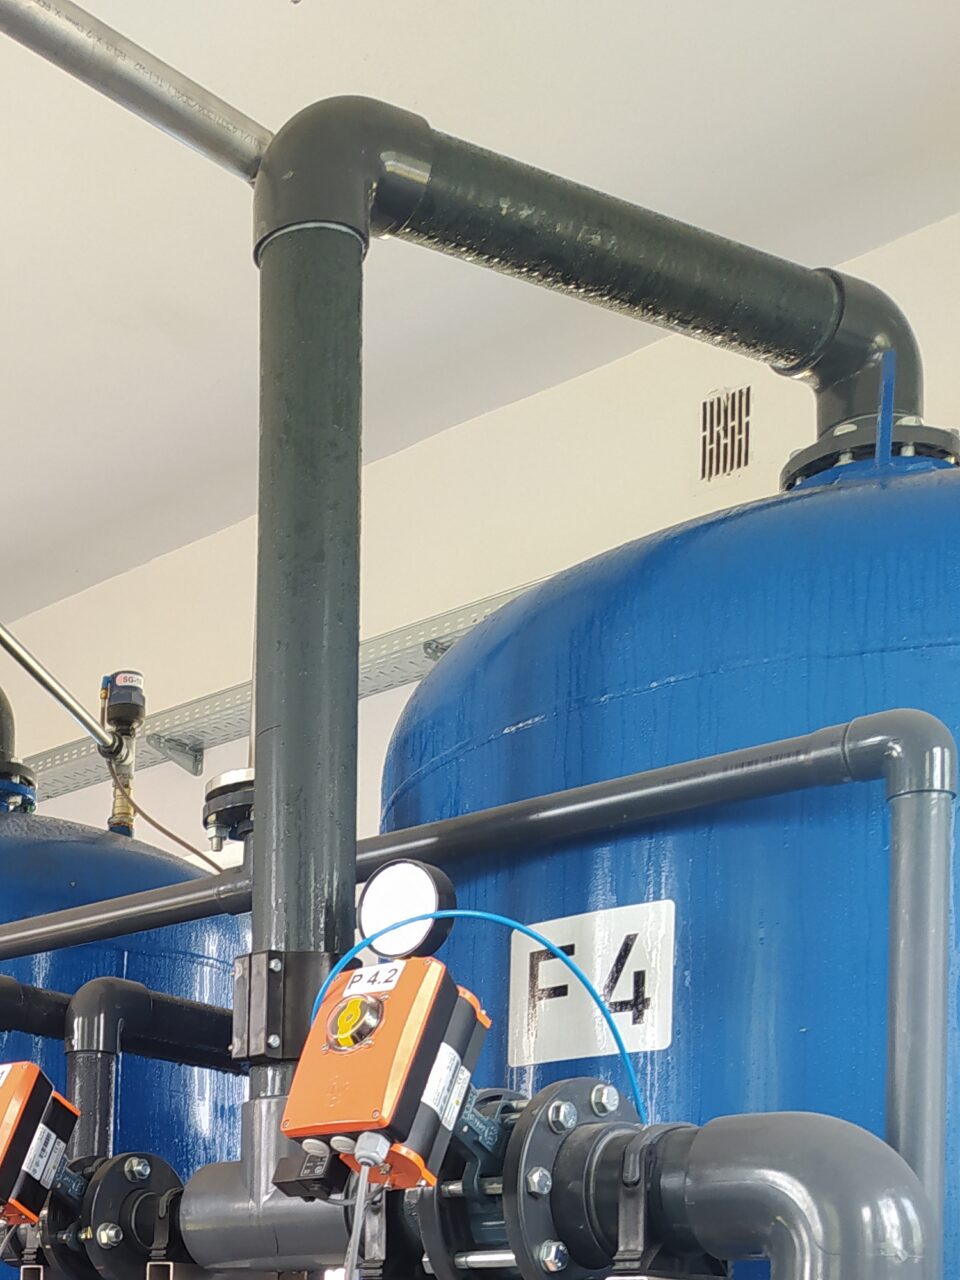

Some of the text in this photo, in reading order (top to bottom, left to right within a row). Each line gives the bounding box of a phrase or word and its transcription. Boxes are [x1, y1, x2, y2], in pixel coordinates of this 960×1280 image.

[347, 968, 398, 990] P 4.2
[527, 932, 651, 1038] F 4
